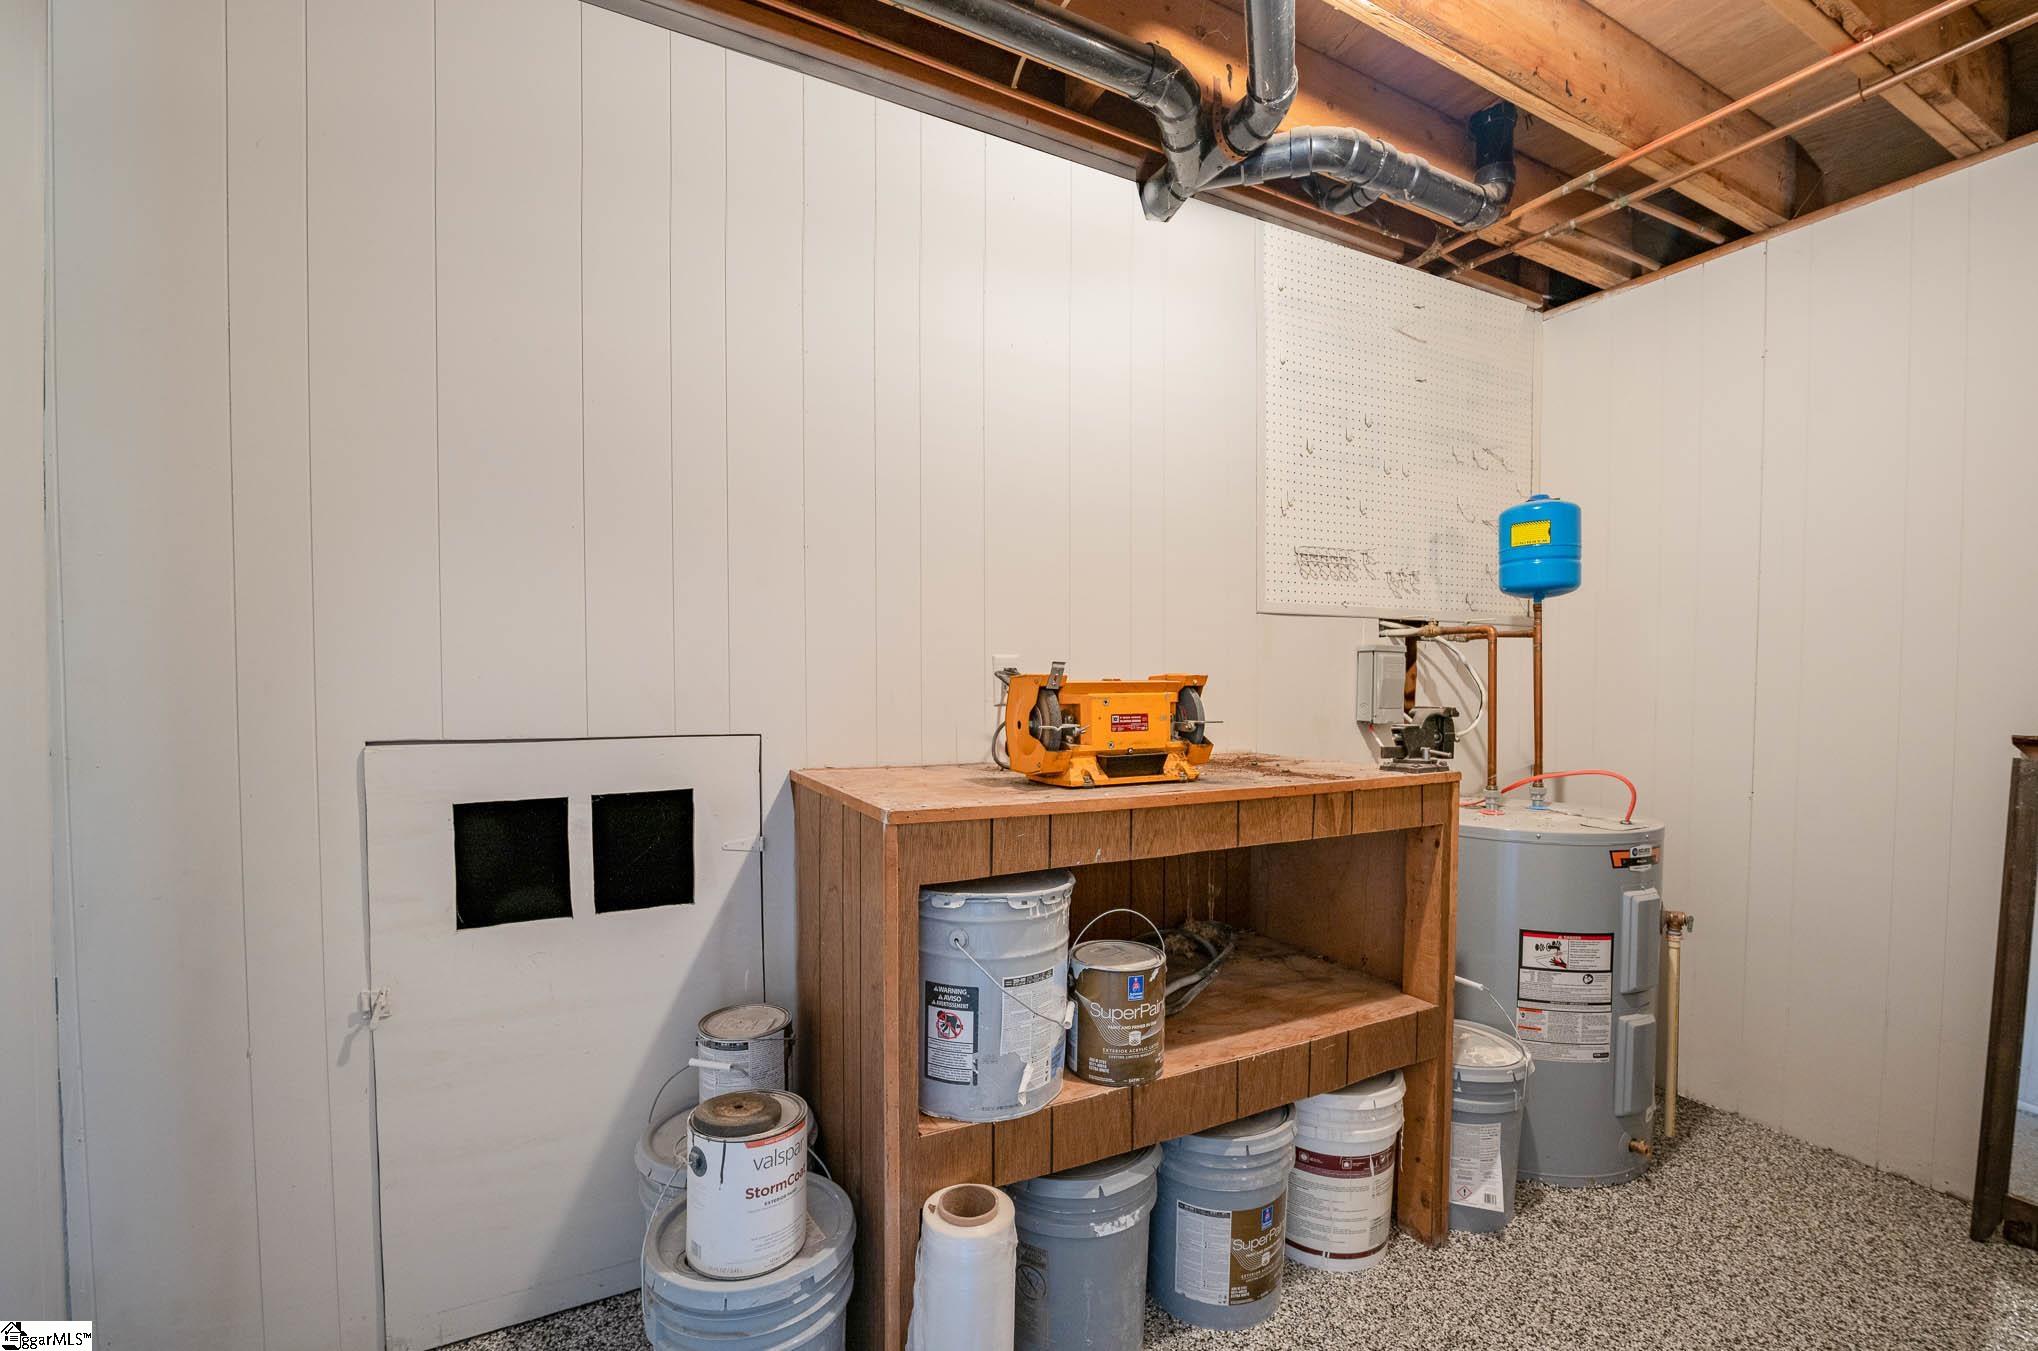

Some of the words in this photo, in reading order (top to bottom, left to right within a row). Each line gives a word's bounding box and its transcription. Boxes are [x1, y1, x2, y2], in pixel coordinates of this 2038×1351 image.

[938, 986, 967, 995] WARNING
[943, 994, 962, 1002] AVISO
[1090, 1000, 1165, 1023] SuperPain
[753, 1136, 805, 1171] valspar
